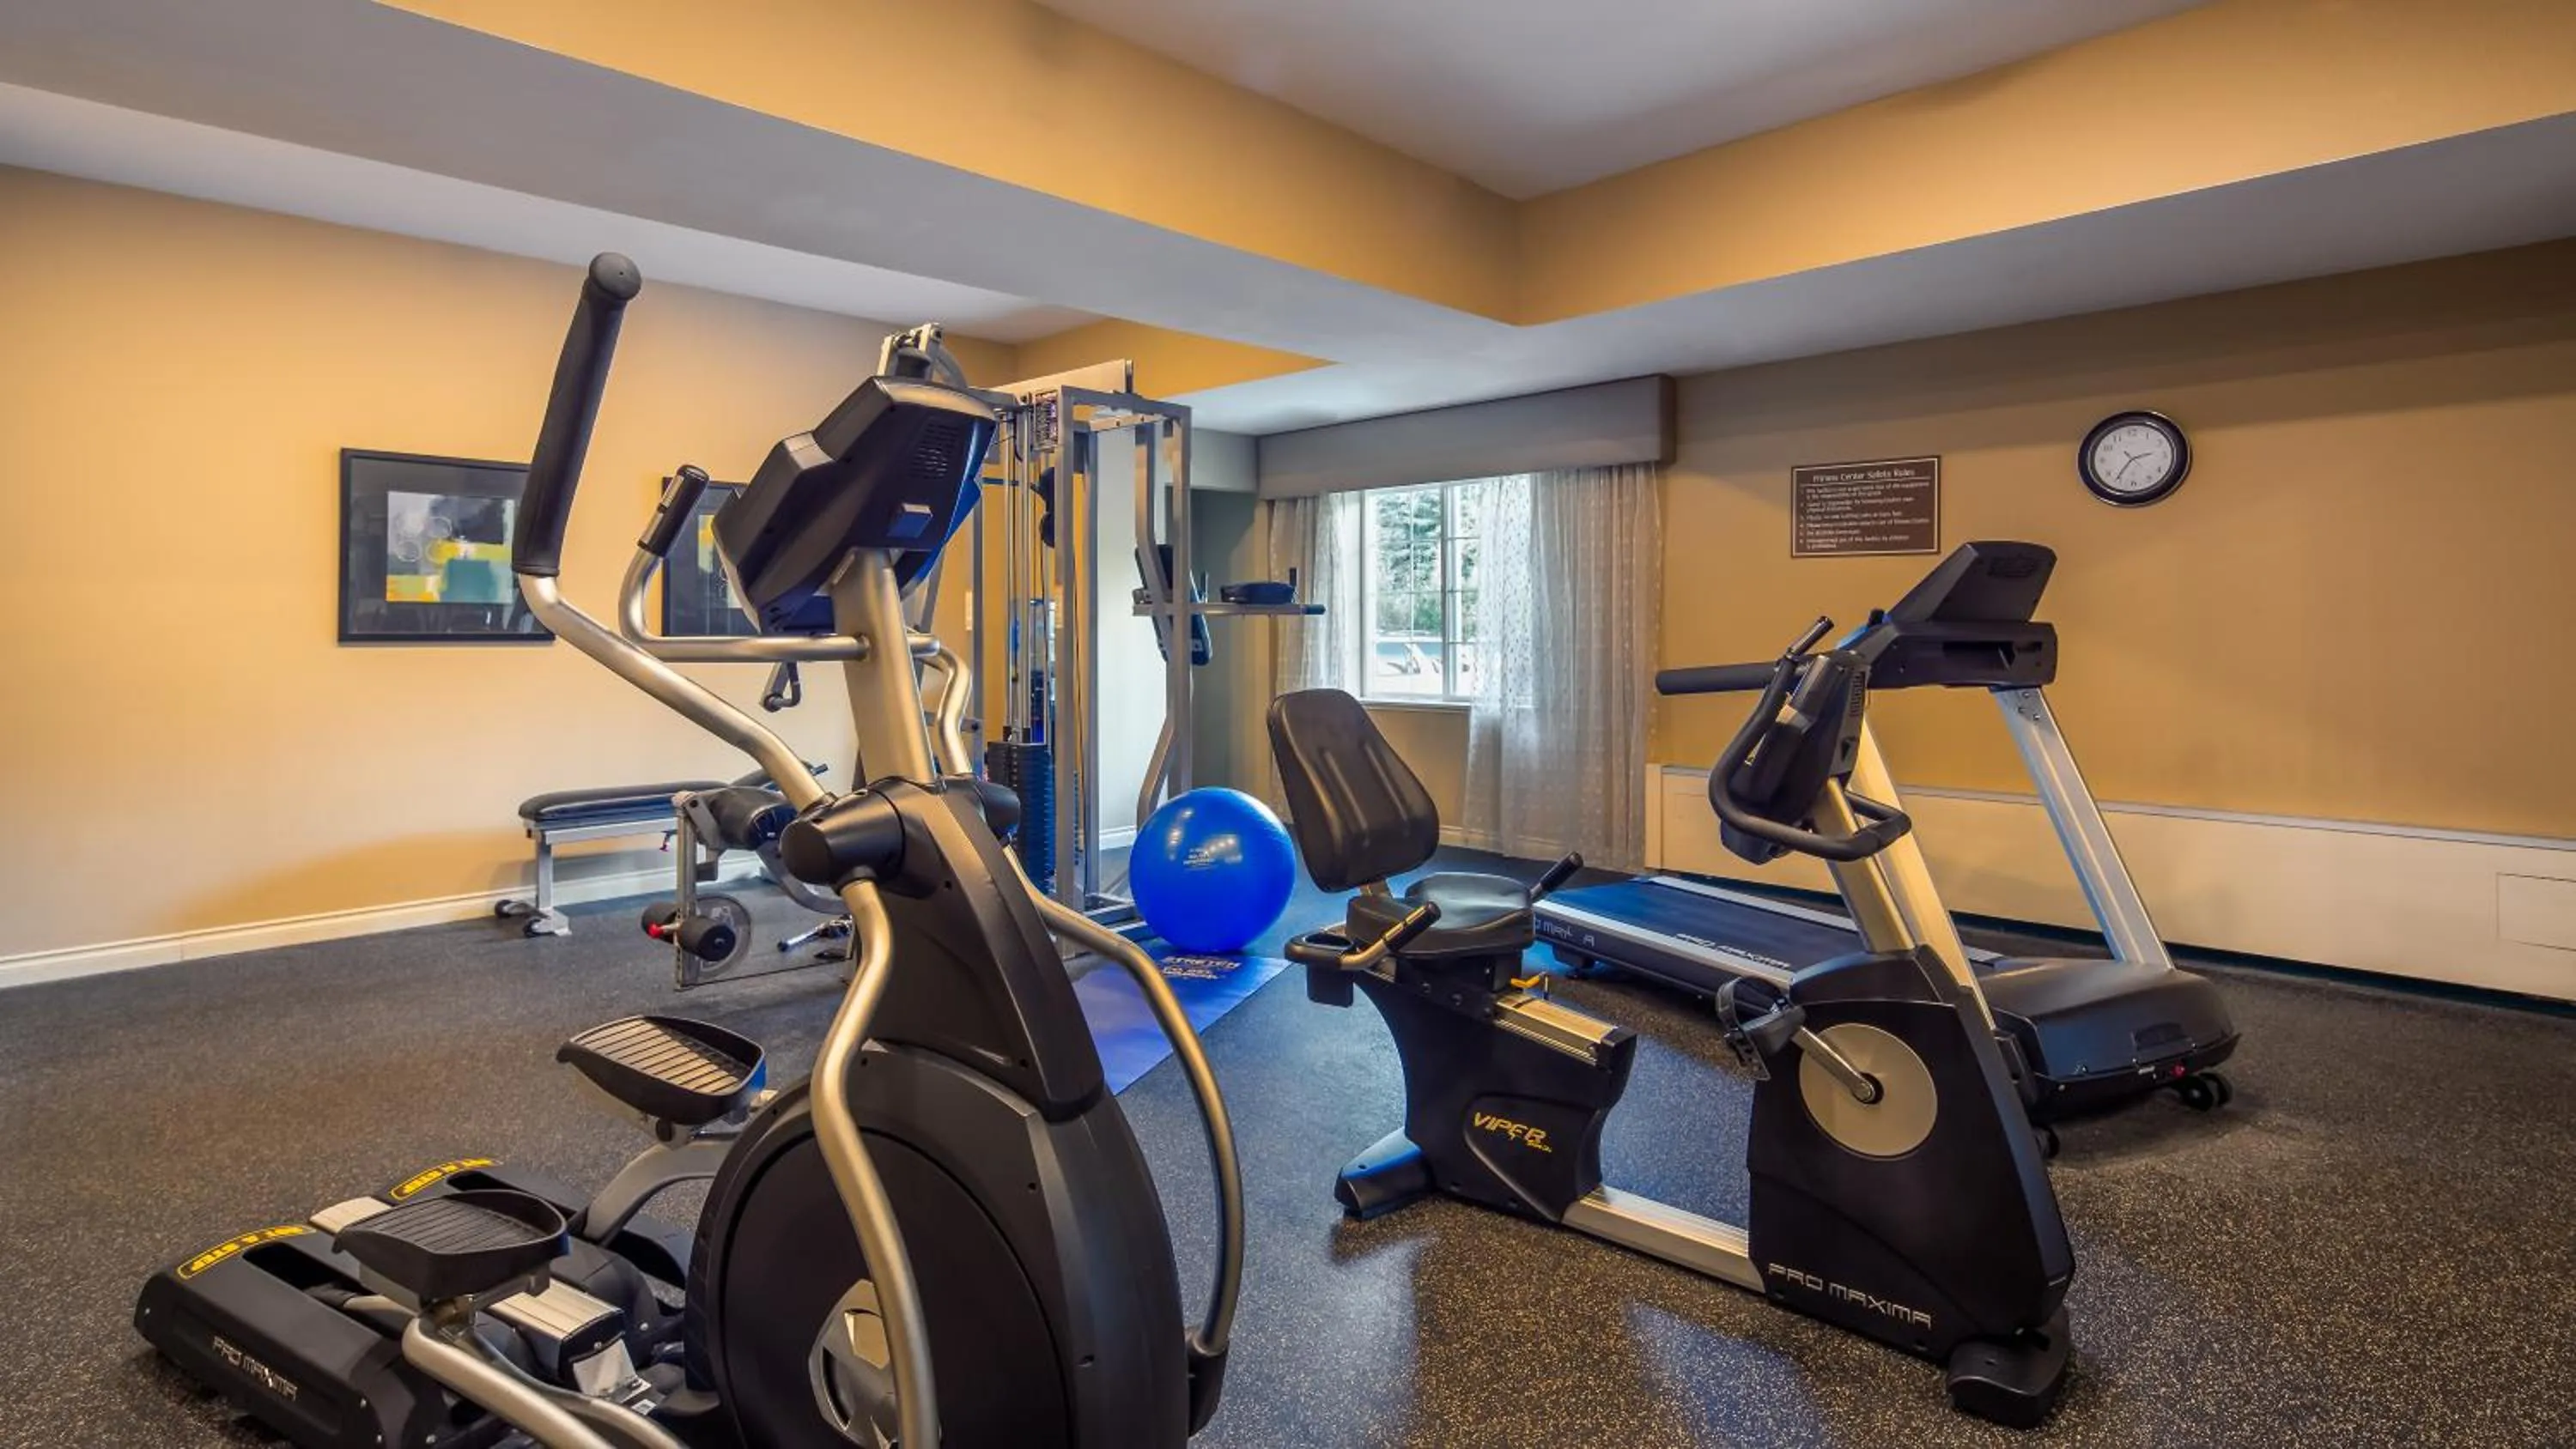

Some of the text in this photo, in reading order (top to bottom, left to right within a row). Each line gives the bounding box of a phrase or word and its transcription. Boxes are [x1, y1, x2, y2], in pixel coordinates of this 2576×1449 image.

[1840, 472, 1865, 482] Center
[1473, 1112, 1547, 1143] VIPER
[1768, 1263, 1931, 1330] PRO MAXIMA
[212, 1336, 242, 1367] PRO
